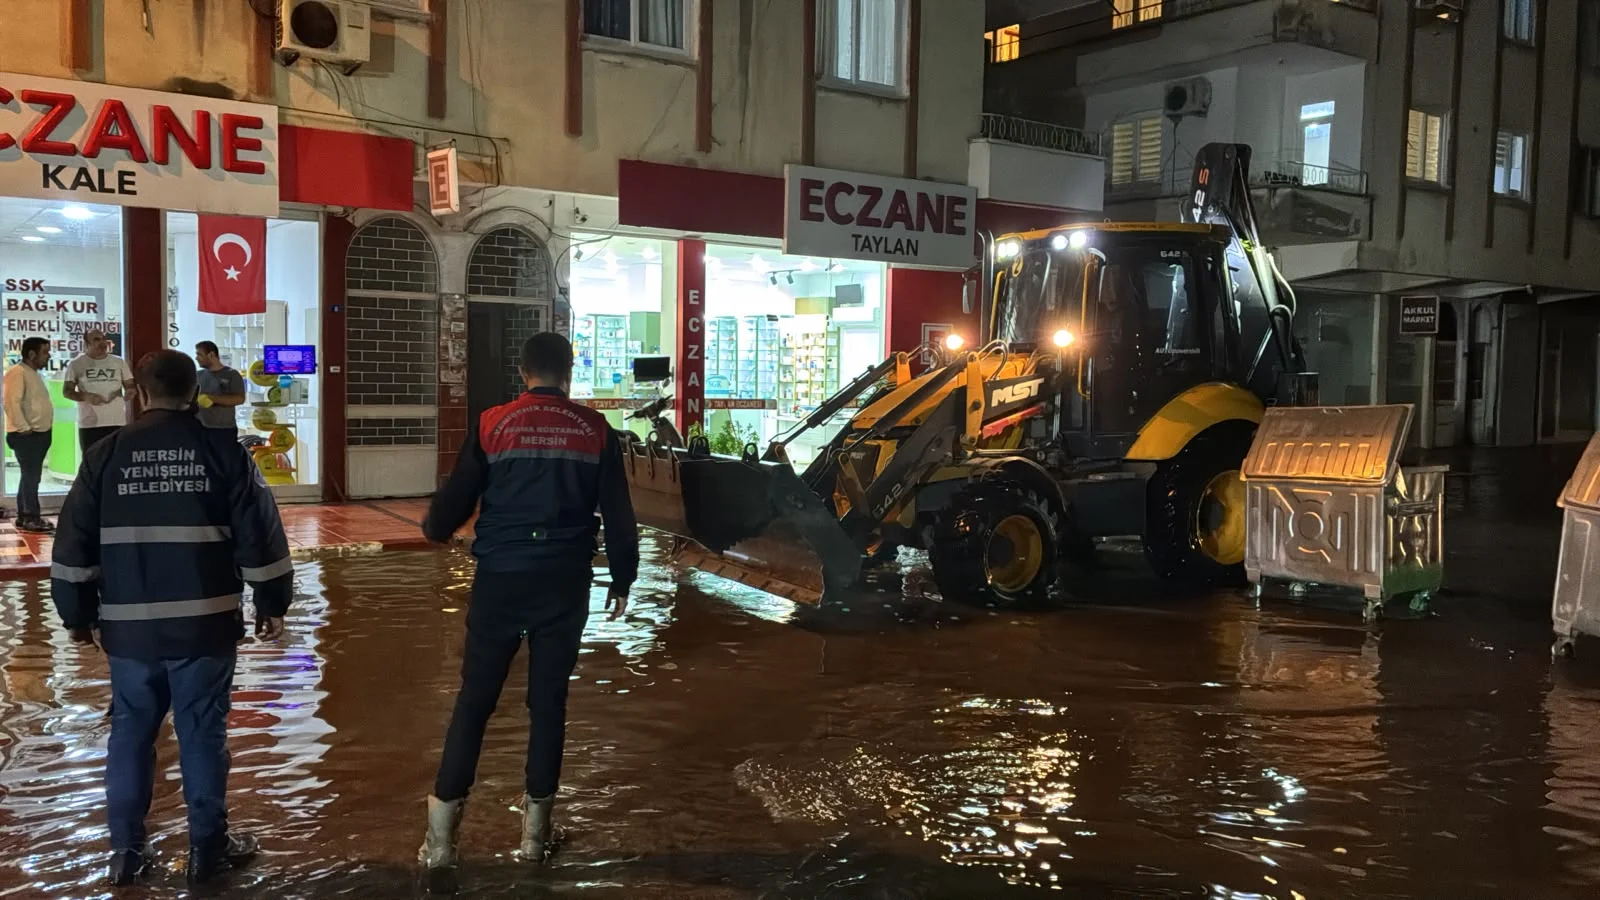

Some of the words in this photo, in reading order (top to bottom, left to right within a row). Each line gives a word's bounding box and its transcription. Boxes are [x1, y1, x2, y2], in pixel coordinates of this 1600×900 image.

[0, 87, 265, 174] ZANE
[42, 163, 137, 196] KALE
[800, 178, 967, 236] ECZANE
[852, 234, 919, 256] TAYLAN
[5, 278, 45, 292] SSK
[7, 295, 98, 314] BAĞ-KUR
[7, 316, 60, 333] EMEKLİ
[65, 316, 121, 335] SANDIĞI
[688, 290, 699, 414] ECZAN
[86, 369, 116, 379] EA7
[991, 378, 1045, 408] MST
[520, 435, 567, 446] MERSİN
[132, 447, 196, 463] MERSİN
[120, 462, 206, 479] YENİŞEHİR
[117, 478, 211, 496] BELEDİYESİ
